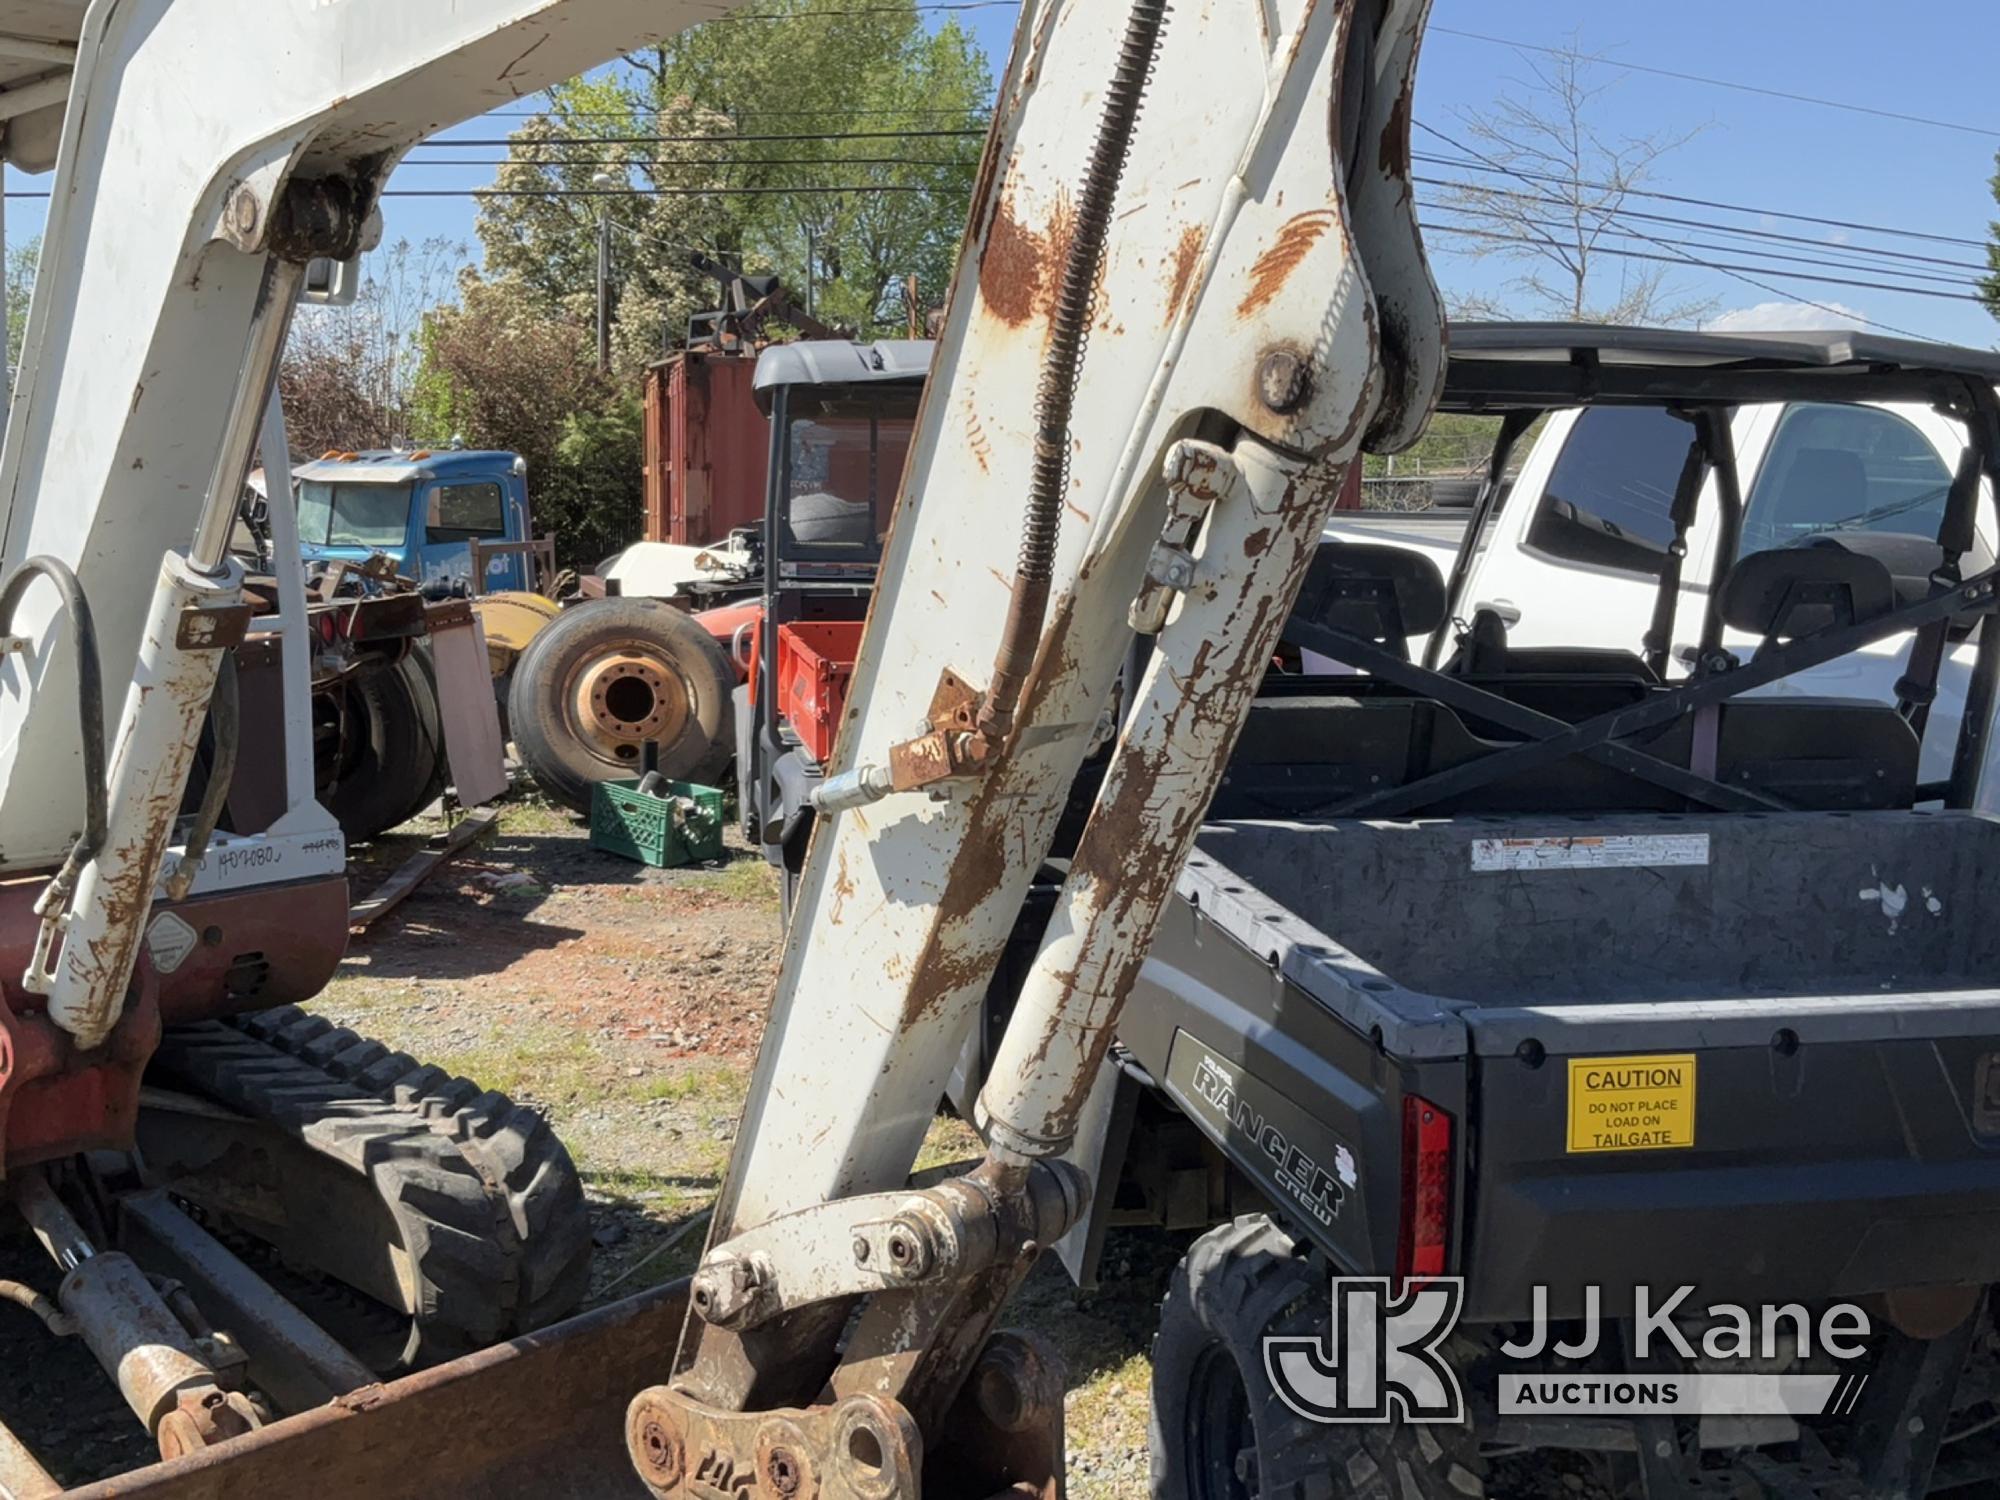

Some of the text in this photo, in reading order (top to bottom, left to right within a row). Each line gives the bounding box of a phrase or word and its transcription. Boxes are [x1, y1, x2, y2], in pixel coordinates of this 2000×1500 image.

[1586, 1069, 1681, 1089] CAUTION
[1589, 1100, 1677, 1114] DO NOT PLACE
[1606, 1116, 1660, 1128] LOAD ON
[1192, 1062, 1345, 1217] RANGER
[1593, 1131, 1672, 1148] TAILGATE
[1274, 1169, 1332, 1226] CREW
